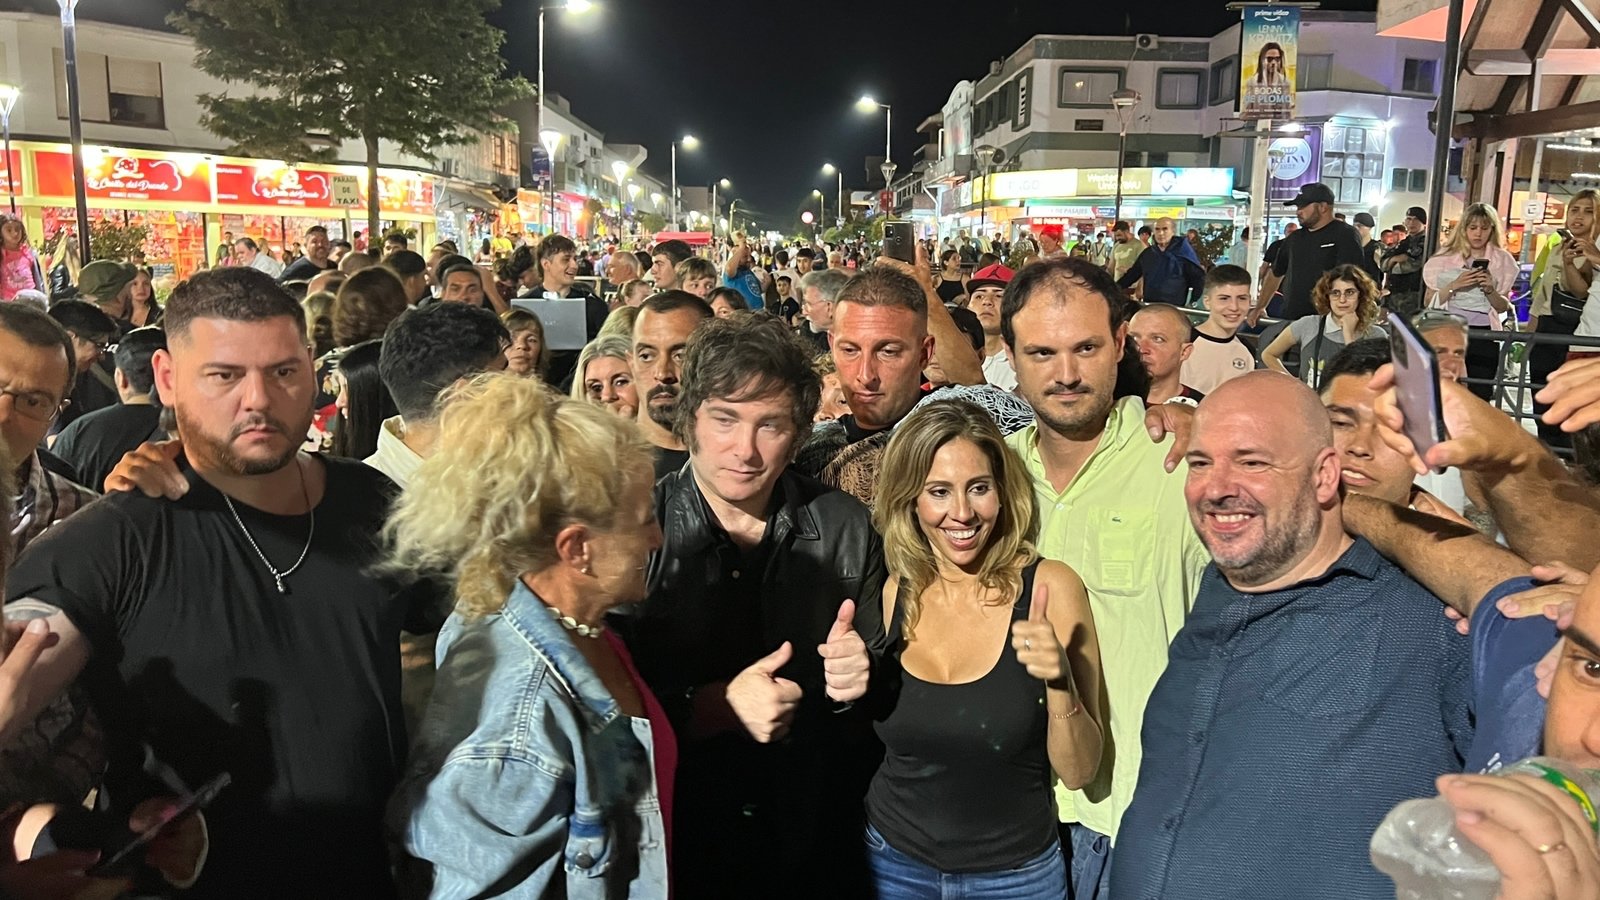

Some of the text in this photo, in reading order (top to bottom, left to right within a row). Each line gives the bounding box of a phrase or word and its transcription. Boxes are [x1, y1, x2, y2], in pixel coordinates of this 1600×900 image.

[1254, 9, 1272, 17] prime
[1258, 25, 1284, 33] LENNY
[1249, 33, 1293, 42] KRAVITZ
[1254, 87, 1282, 95] BODAS
[1258, 95, 1292, 103] PLOMO
